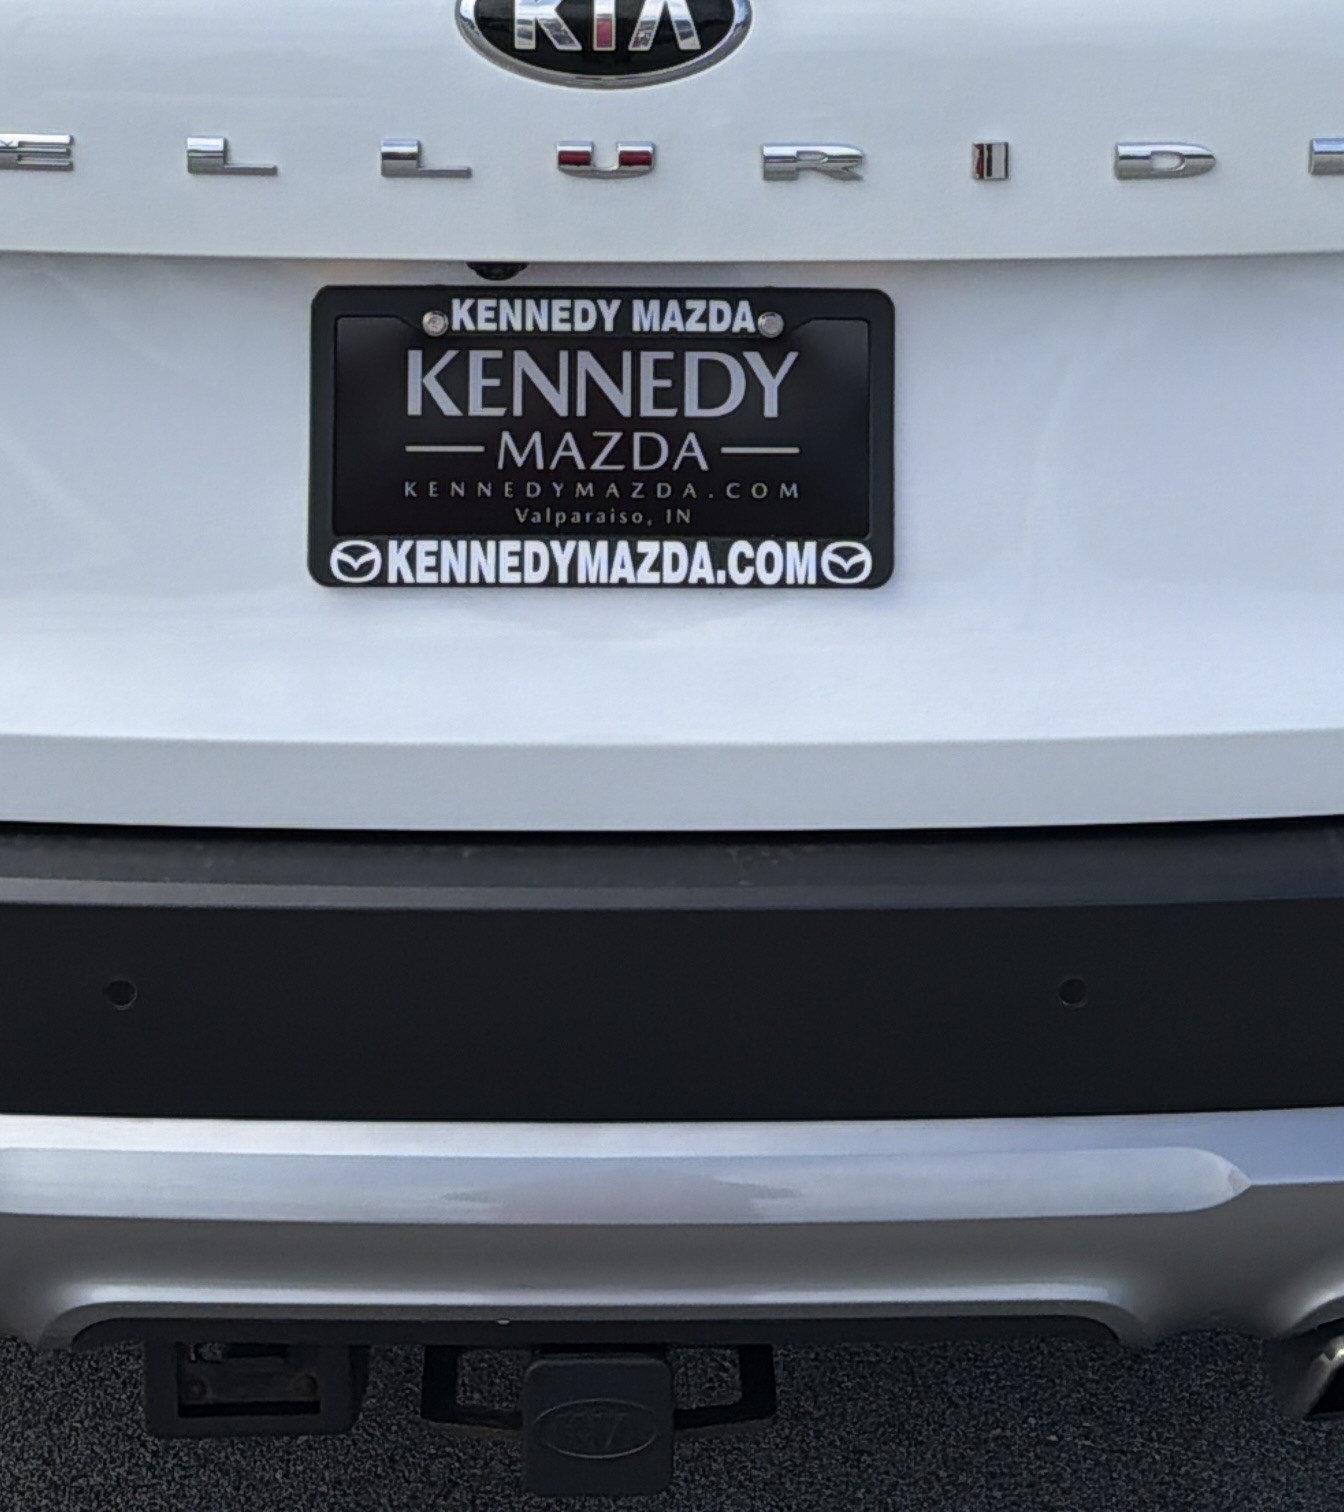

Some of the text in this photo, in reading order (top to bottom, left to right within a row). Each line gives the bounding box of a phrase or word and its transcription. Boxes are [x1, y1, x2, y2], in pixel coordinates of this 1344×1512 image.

[451, 298, 755, 334] KENNEDY MAZDA
[406, 349, 799, 418] KENNEDY
[497, 431, 710, 472] MAZDA
[404, 481, 800, 500] KENNEDYMAZDA.COM
[515, 507, 692, 528] Valparaiso, IN
[387, 540, 818, 586] KENNEDYMAZDA.COM
